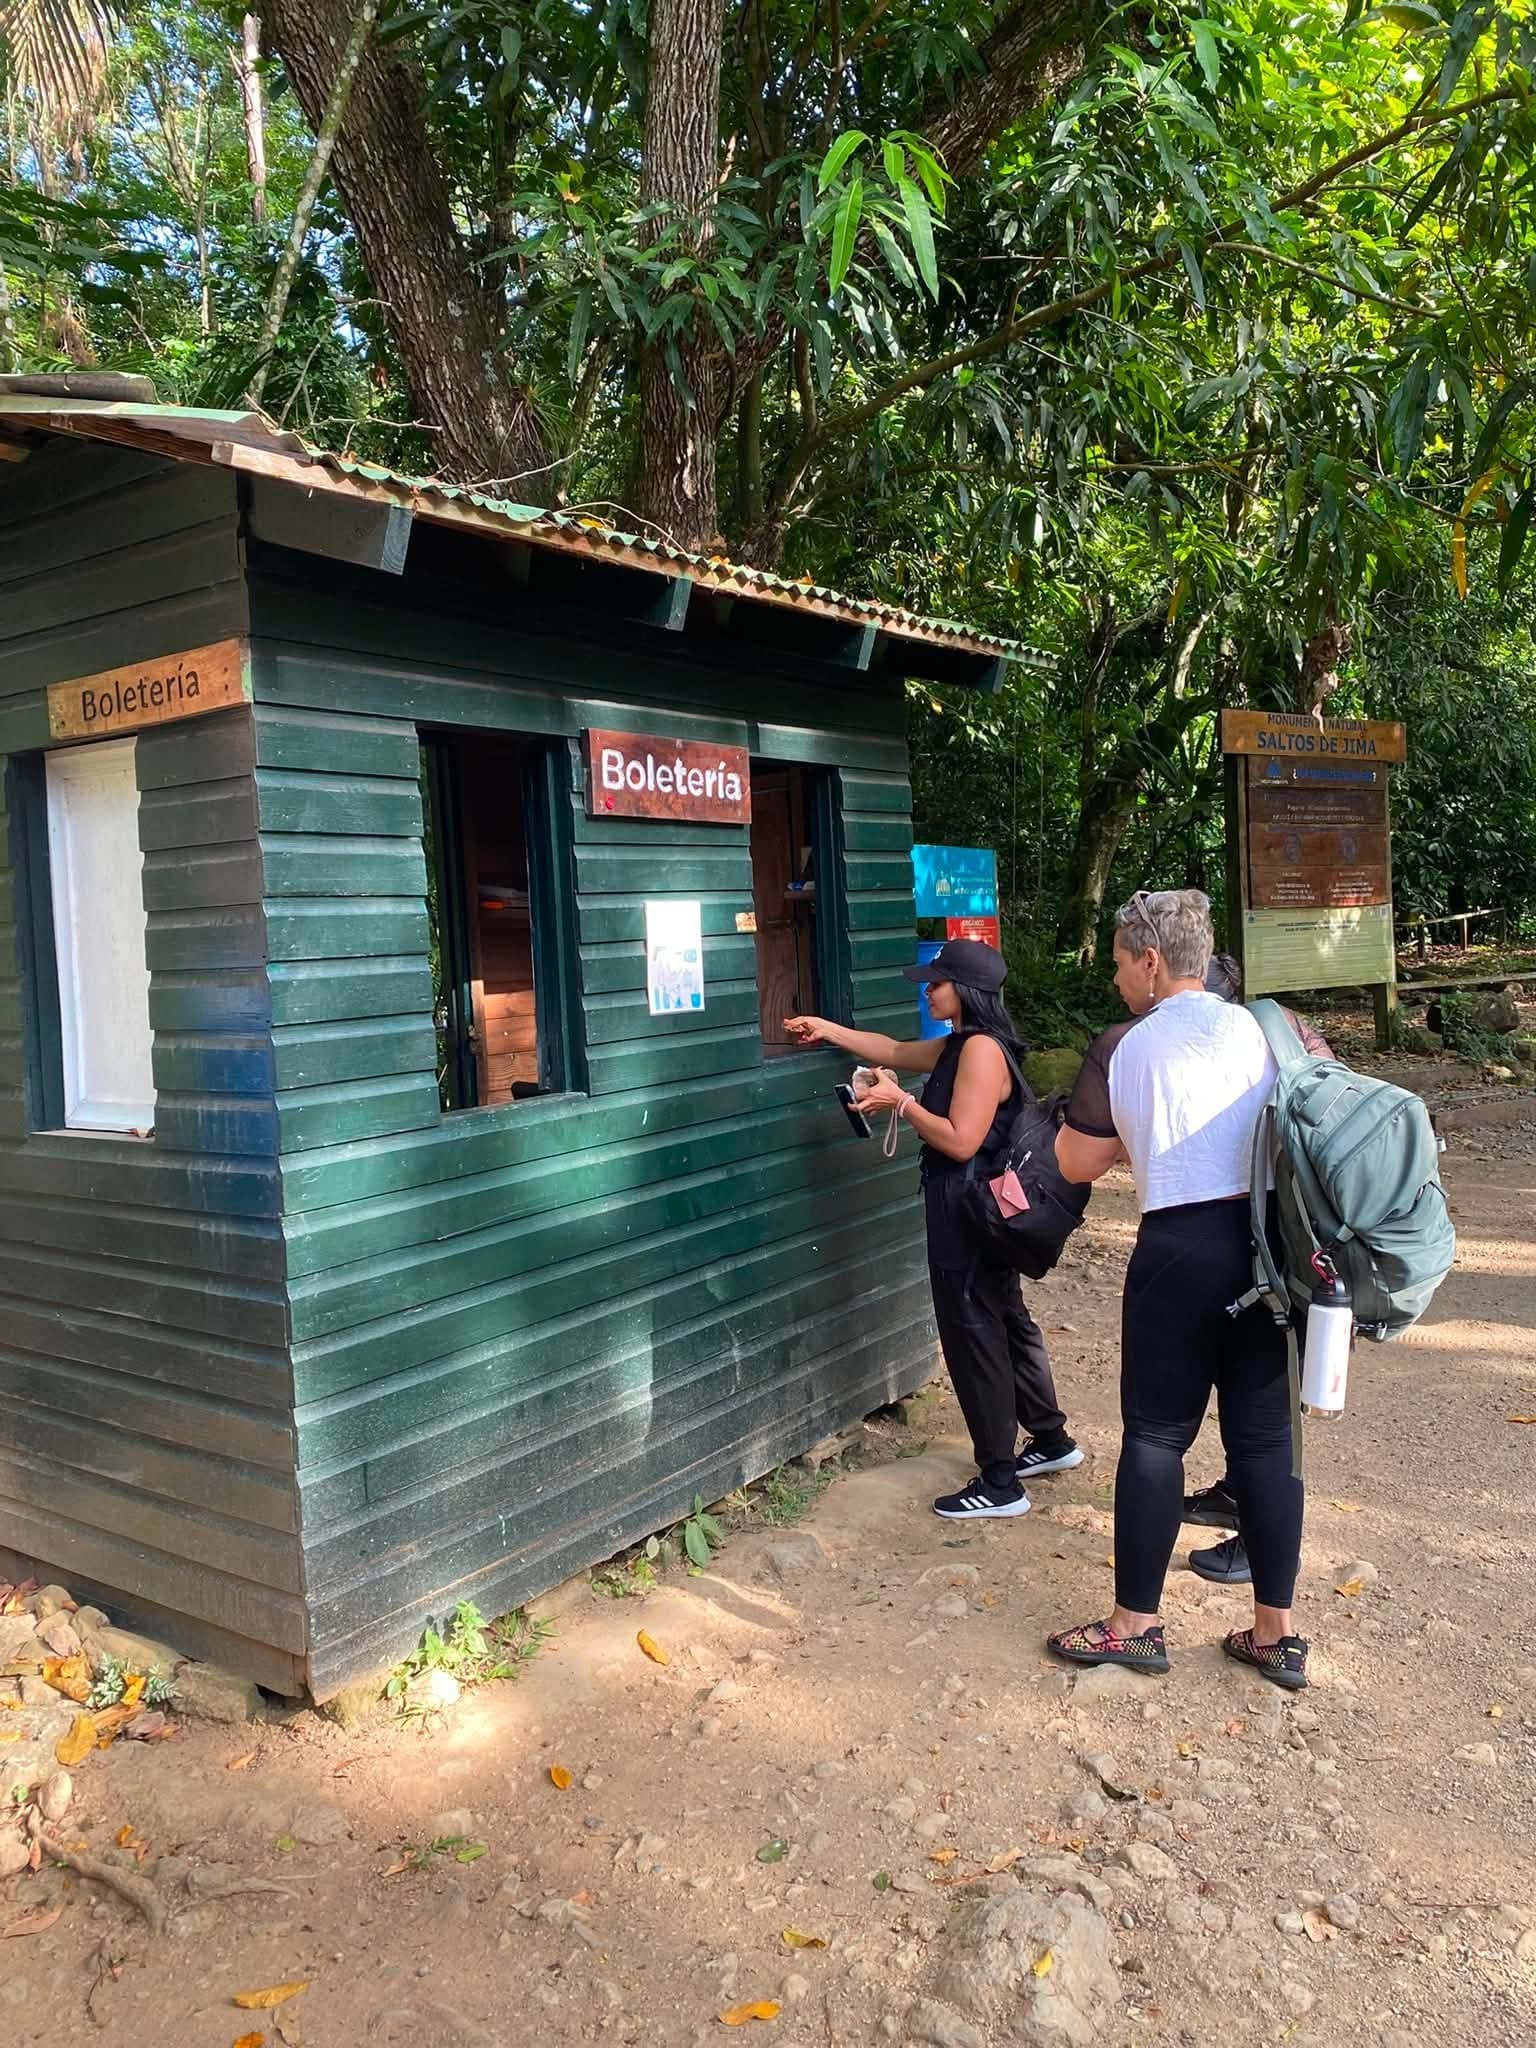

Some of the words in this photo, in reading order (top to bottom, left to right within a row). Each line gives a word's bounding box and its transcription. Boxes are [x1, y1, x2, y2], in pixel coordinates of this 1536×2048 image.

[81, 662, 200, 722] Boletería
[1257, 731, 1315, 752] SALTOS
[1319, 736, 1338, 753] DE
[1342, 737, 1377, 755] JIMA
[600, 747, 742, 801] Boletería
